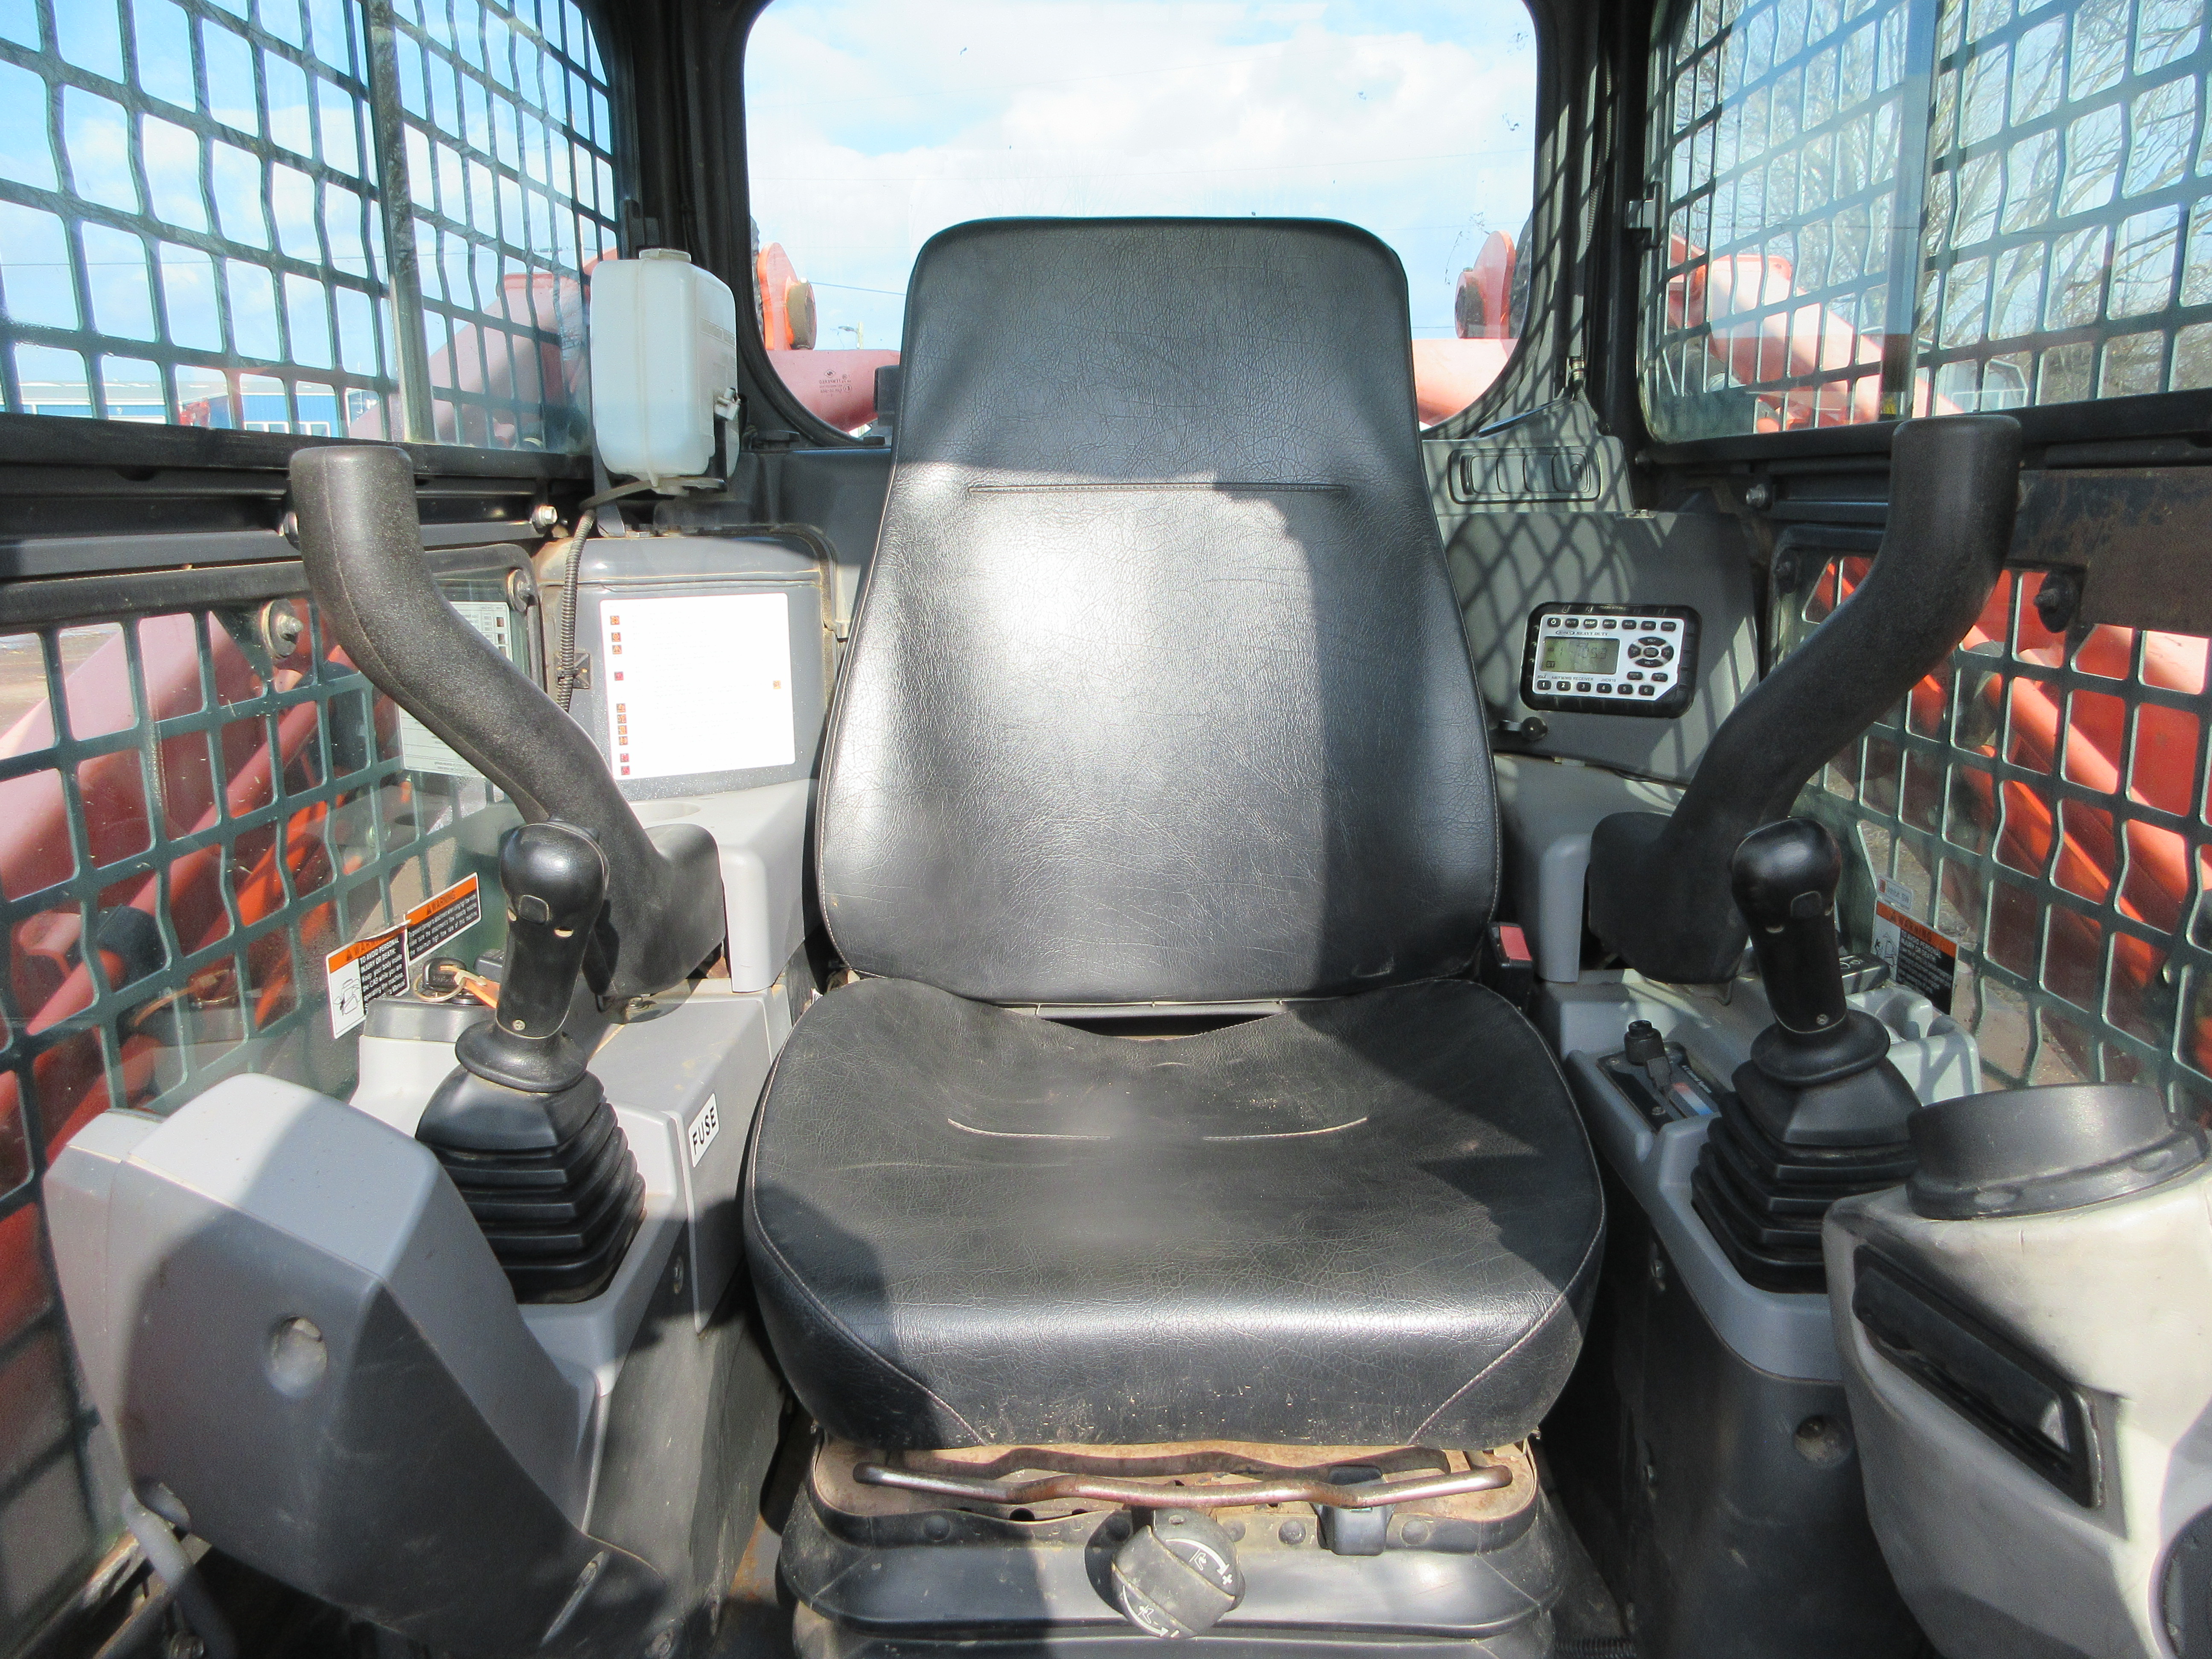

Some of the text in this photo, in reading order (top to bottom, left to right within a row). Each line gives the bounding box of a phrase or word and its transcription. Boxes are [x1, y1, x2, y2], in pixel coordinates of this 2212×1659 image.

[367, 949, 378, 960] AVOID
[379, 938, 399, 953] PERSONAL
[370, 977, 378, 987] CAB
[693, 1106, 716, 1155] FUSE
